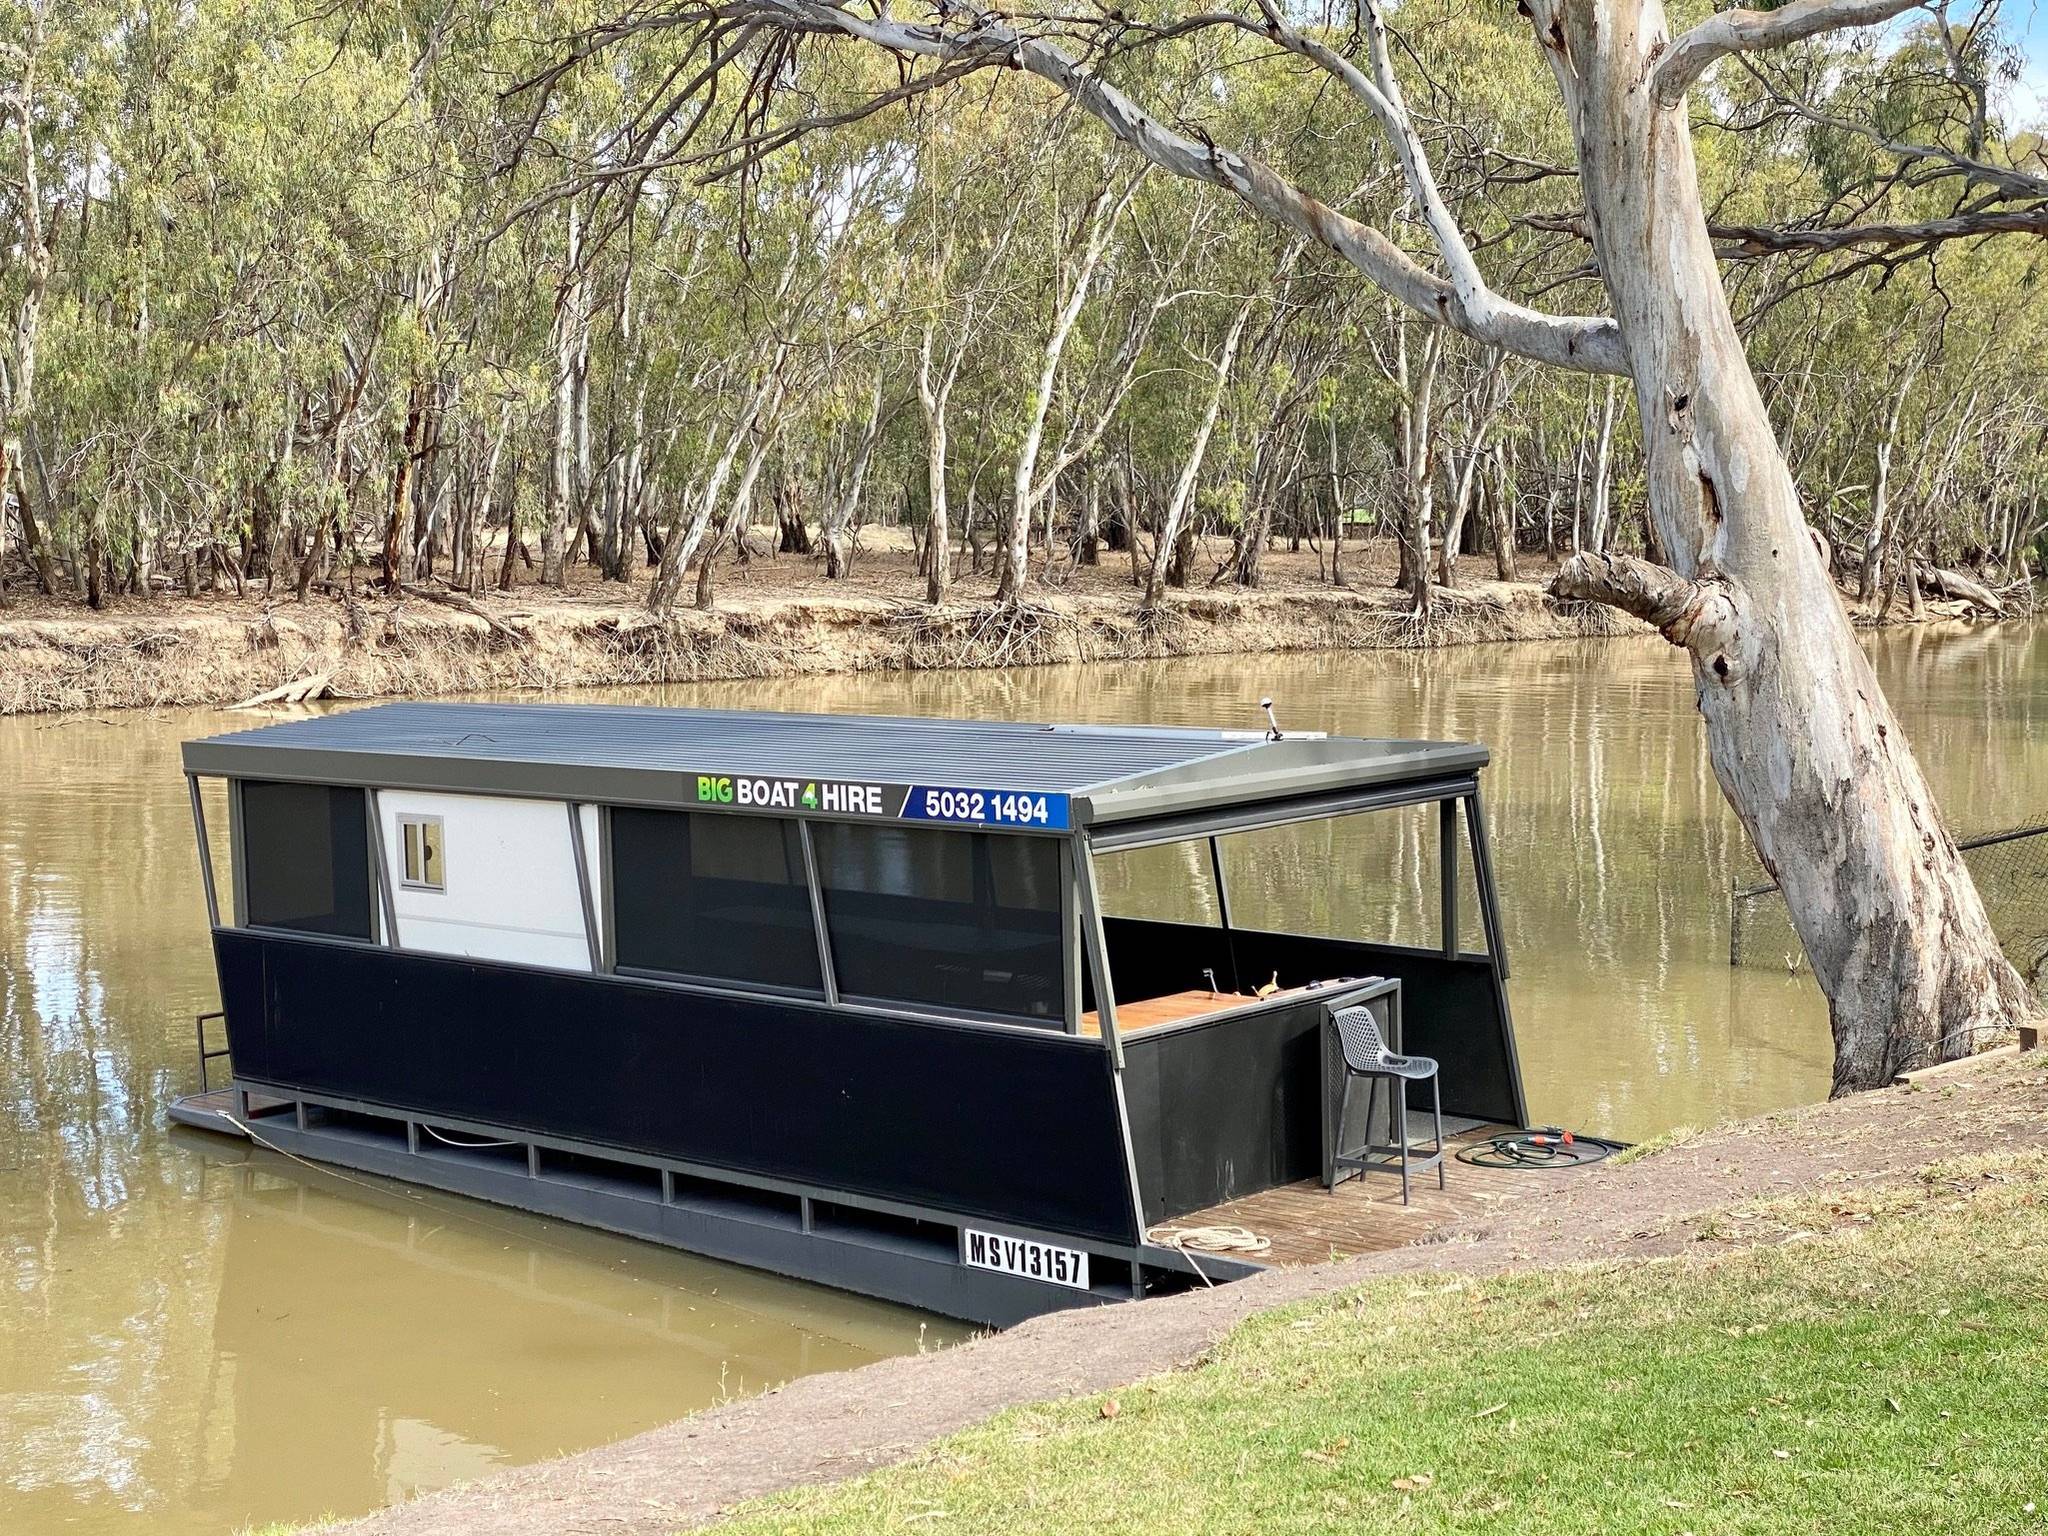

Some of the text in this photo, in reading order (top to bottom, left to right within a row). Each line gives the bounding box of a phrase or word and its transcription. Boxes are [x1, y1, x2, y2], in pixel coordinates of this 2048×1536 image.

[697, 776, 883, 814] BIG BOAT 4 HIRE
[925, 791, 1049, 823] 5032 1494
